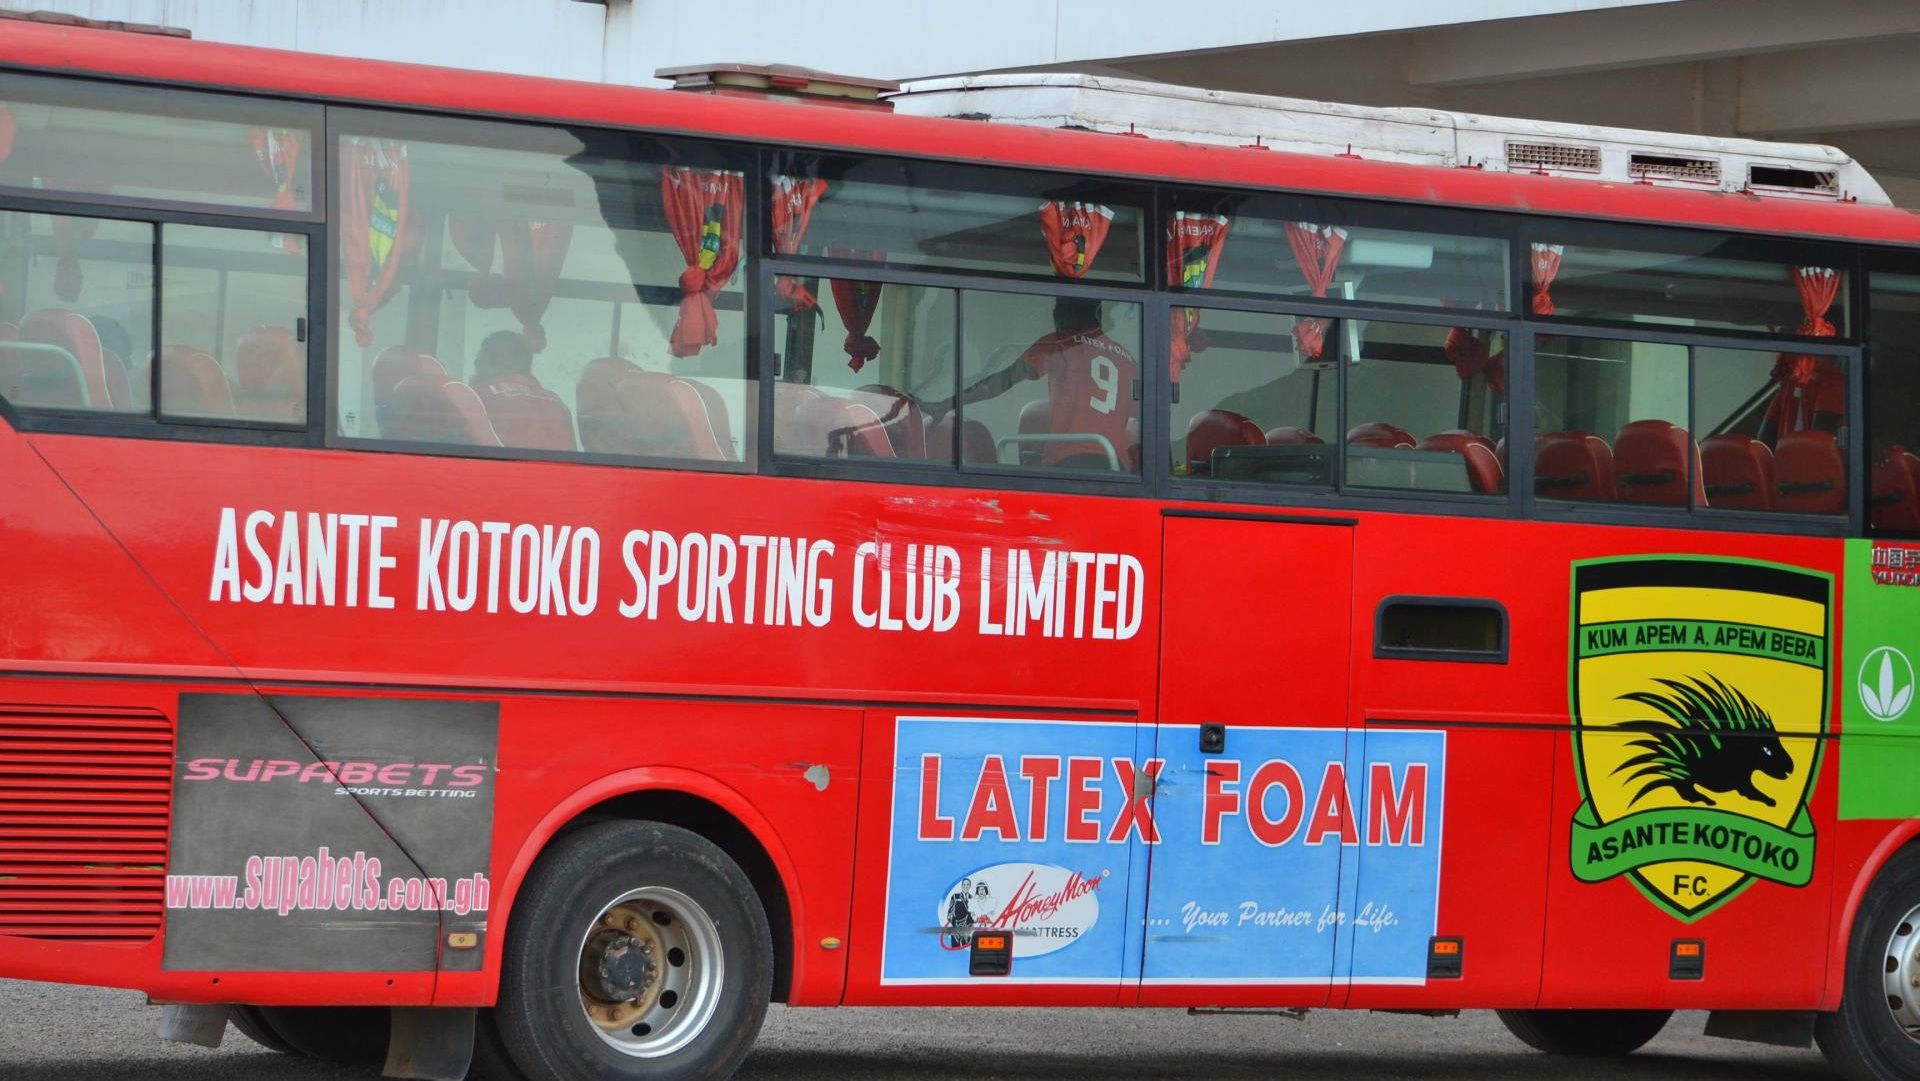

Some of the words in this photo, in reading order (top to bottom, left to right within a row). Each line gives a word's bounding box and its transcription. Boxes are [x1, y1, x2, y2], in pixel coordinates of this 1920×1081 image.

[1090, 355, 1118, 414] 9
[209, 507, 398, 609] ASANTE
[416, 518, 600, 616] KOTOKO
[618, 529, 835, 627] SPORTING
[851, 540, 961, 632] CLUB
[978, 547, 1144, 640] LIMITED
[1588, 627, 1627, 649] KUM
[1635, 625, 1687, 645] APEM
[1714, 627, 1766, 650] APEM
[1771, 633, 1816, 660] BEBA
[183, 758, 488, 786] SUPABETS
[334, 787, 402, 797] SPORTS
[405, 789, 476, 798] BETTING
[917, 753, 1165, 845] LATEX
[1201, 758, 1428, 847] FOAM
[1586, 822, 1688, 864] ASANTE
[1694, 824, 1799, 871] KOTOKO
[166, 847, 490, 916] www.supabets.com.gh
[1673, 874, 1710, 896] F.C.
[1181, 901, 1230, 934] Your
[1237, 901, 1313, 927] Partner
[1316, 904, 1346, 934] for
[1351, 901, 1400, 933] Life.
